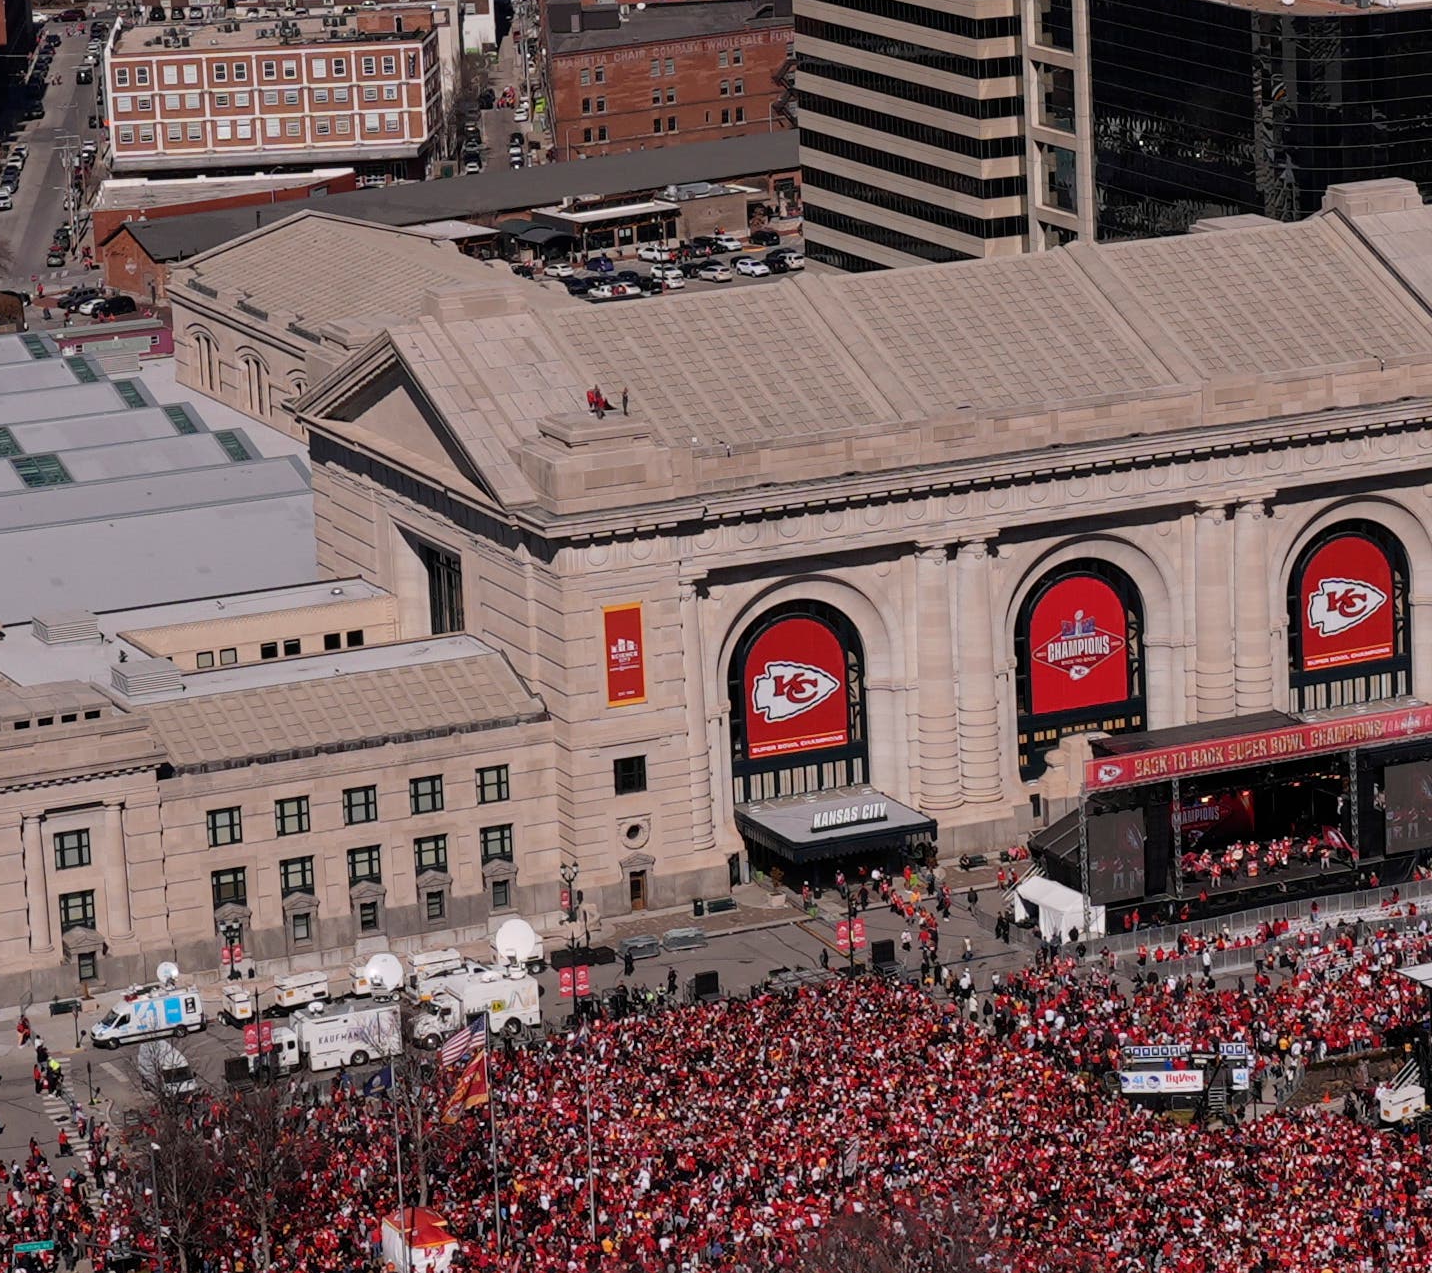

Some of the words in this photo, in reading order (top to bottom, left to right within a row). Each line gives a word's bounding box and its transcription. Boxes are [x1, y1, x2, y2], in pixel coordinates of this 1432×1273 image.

[614, 50, 647, 64] CHAIR
[653, 40, 702, 60] COMPANY
[707, 35, 764, 55] WHOLESALE
[1047, 634, 1110, 663] CHAMPIONS
[1228, 738, 1268, 767] SUPER
[1271, 734, 1306, 757] BOWL
[1310, 720, 1383, 750] CHAMPIONS
[814, 804, 859, 829] KANSAS
[861, 801, 888, 822] CITY
